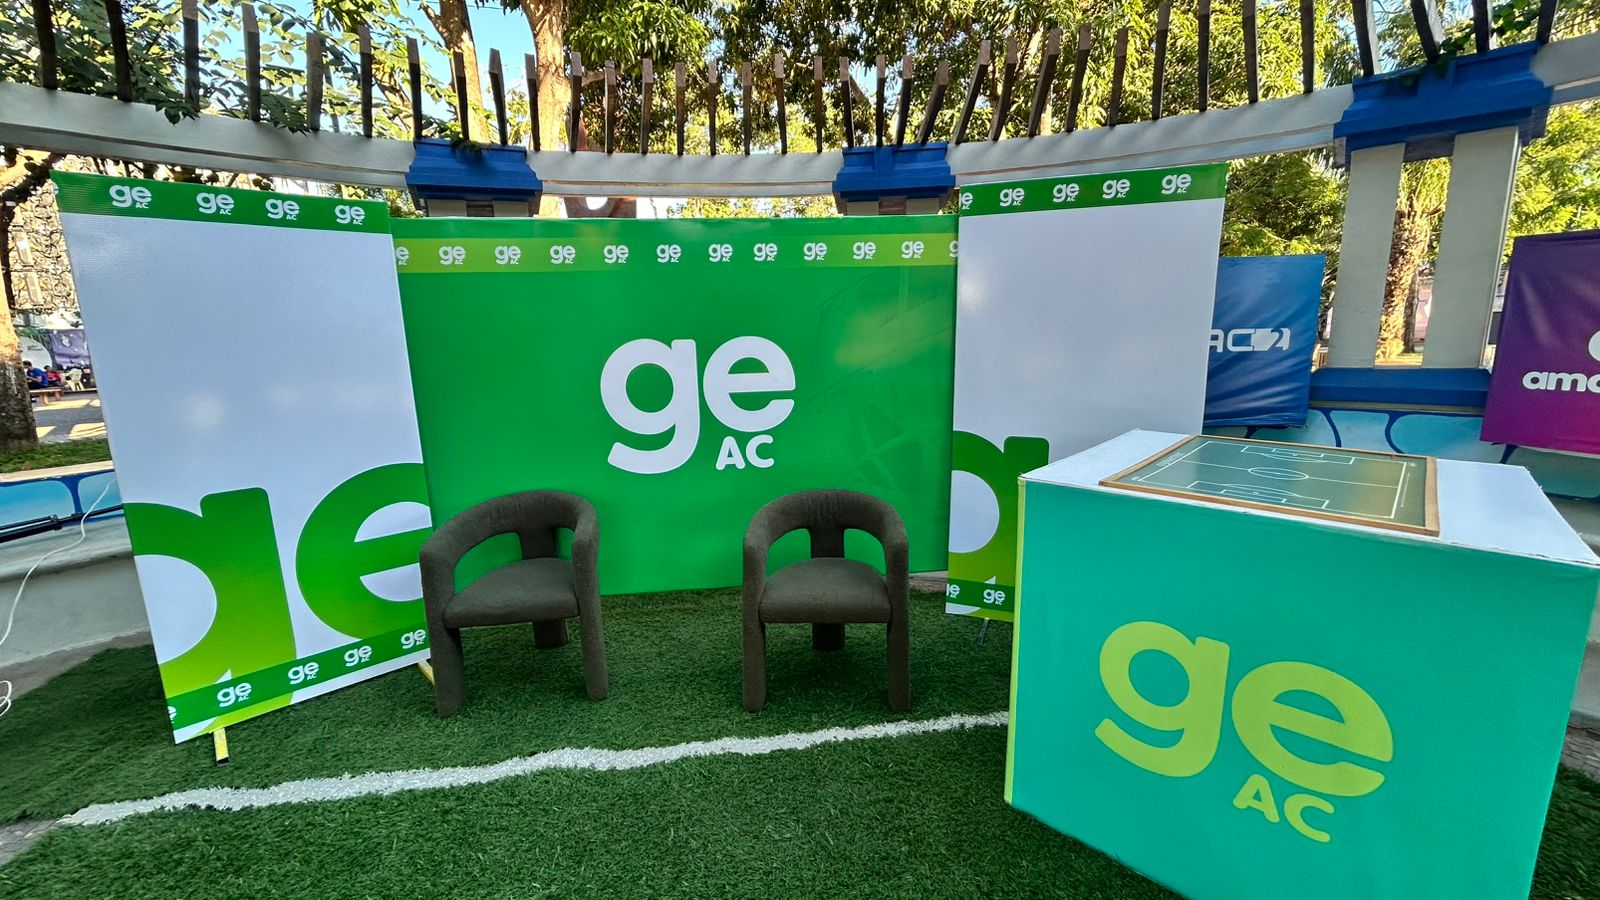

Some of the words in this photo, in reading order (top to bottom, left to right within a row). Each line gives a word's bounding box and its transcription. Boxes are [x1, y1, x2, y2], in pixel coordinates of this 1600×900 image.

[1053, 183, 1080, 202] ge
[1102, 179, 1130, 199] ge
[1161, 174, 1192, 194] ge
[110, 184, 152, 208] ge
[196, 192, 234, 214] ge
[1000, 188, 1024, 206] ge
[265, 199, 300, 219] ge
[335, 205, 365, 224] ge
[439, 246, 466, 265] ge
[495, 245, 521, 264] ge
[550, 245, 576, 264] ge
[604, 245, 629, 263] ge
[656, 244, 682, 263] ge
[708, 244, 733, 262] ge
[753, 243, 777, 261] ge
[803, 242, 827, 260] ge
[853, 241, 876, 259] ge
[901, 241, 924, 258] ge
[600, 336, 796, 474] ge
[716, 434, 774, 470] AC
[983, 589, 1005, 603] ge
[401, 629, 426, 649] ge
[344, 645, 372, 667] ge
[288, 662, 319, 684] ge
[217, 682, 252, 707] ge
[1095, 621, 1393, 797] ge
[1233, 774, 1335, 843] AC
